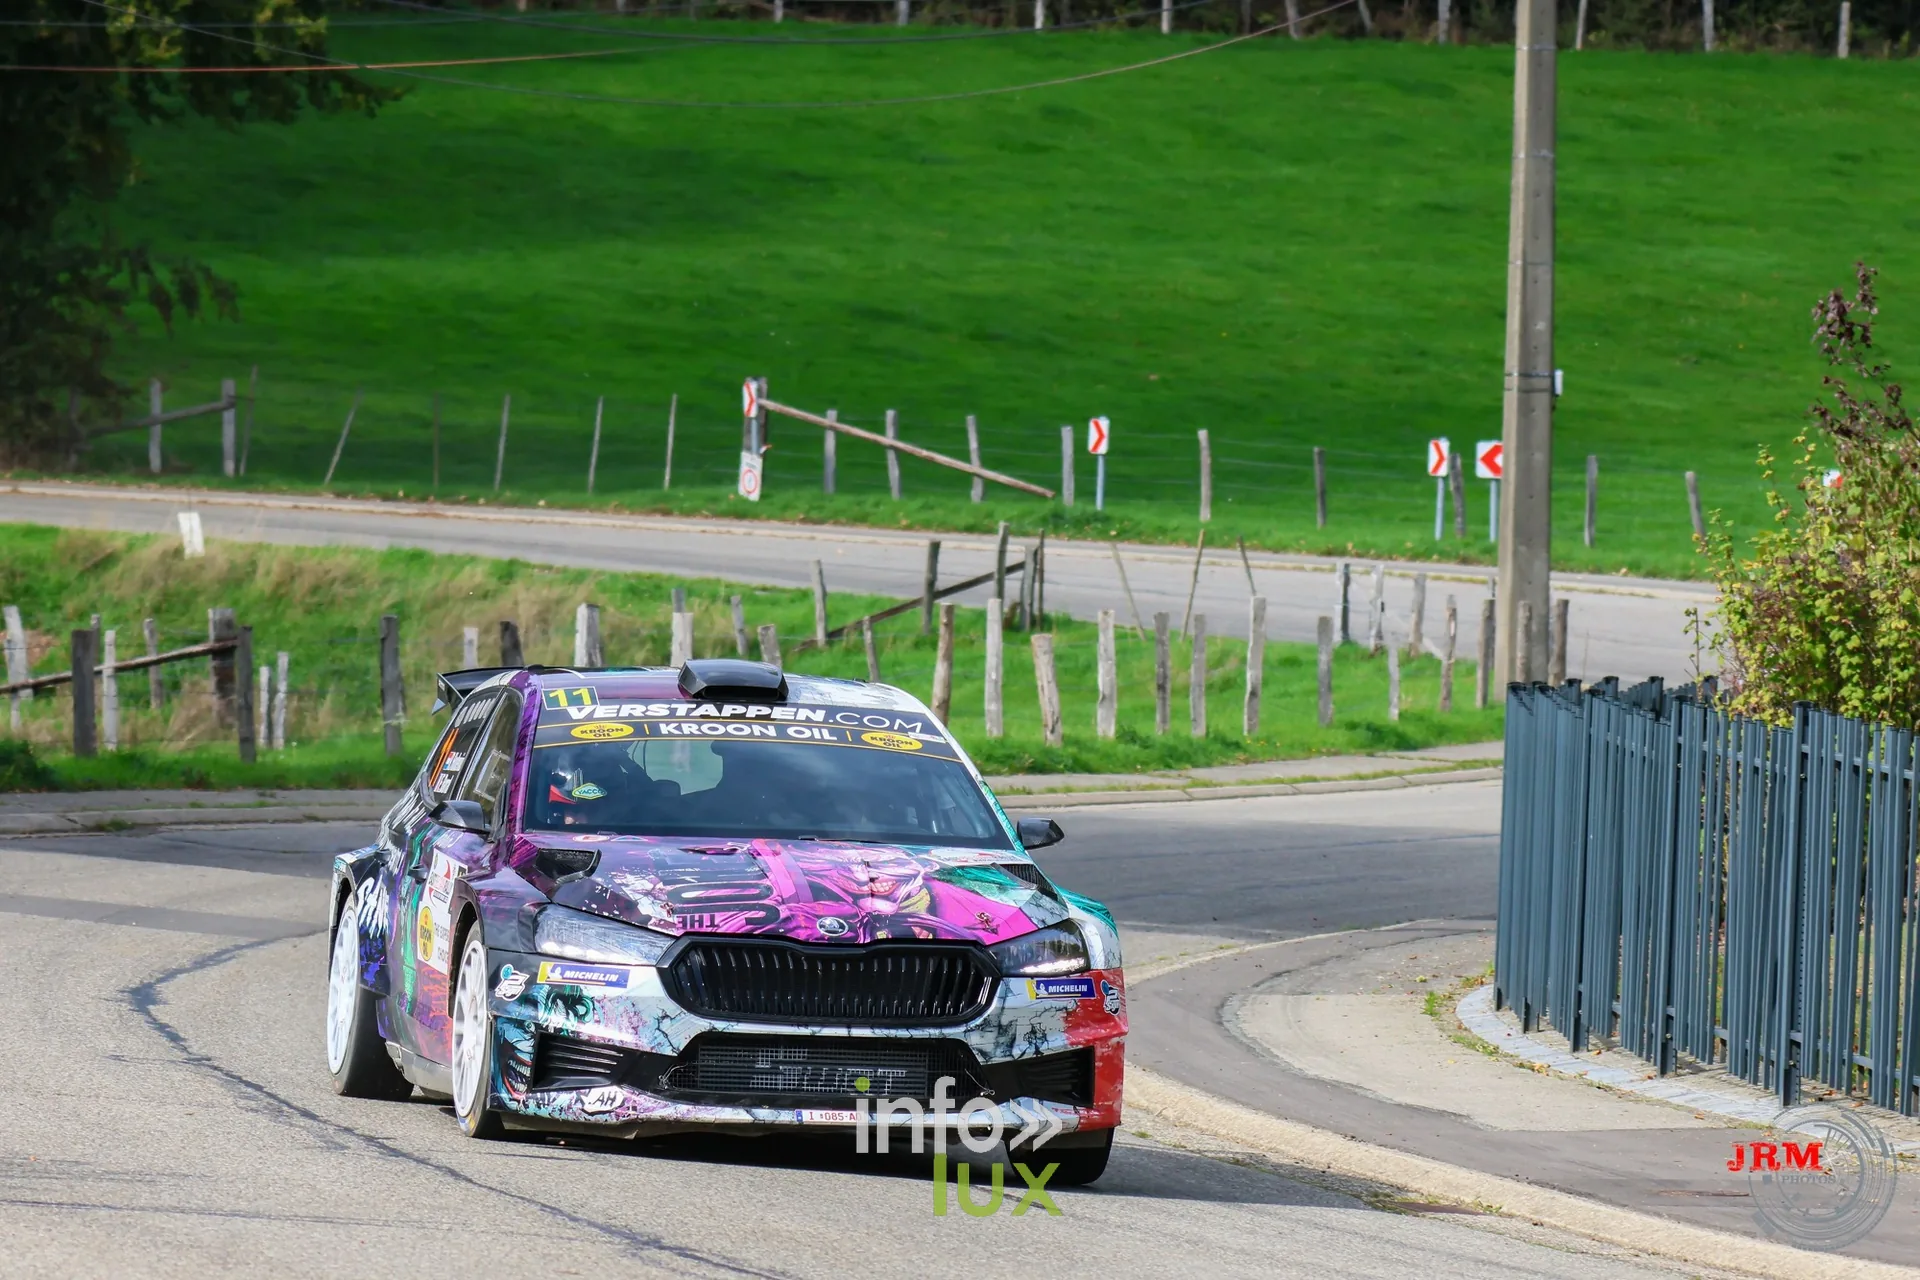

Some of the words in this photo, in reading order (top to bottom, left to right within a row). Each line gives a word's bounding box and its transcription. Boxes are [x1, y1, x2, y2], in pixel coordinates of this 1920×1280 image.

[549, 687, 593, 707] 11
[566, 703, 923, 734] VERSTAPPEN.COM
[659, 722, 777, 737] KROON
[786, 726, 838, 741] OIL
[869, 735, 914, 746] KROON
[675, 913, 719, 929] THE
[563, 970, 620, 982] MICHELIN
[1048, 984, 1088, 993] MICHELIN
